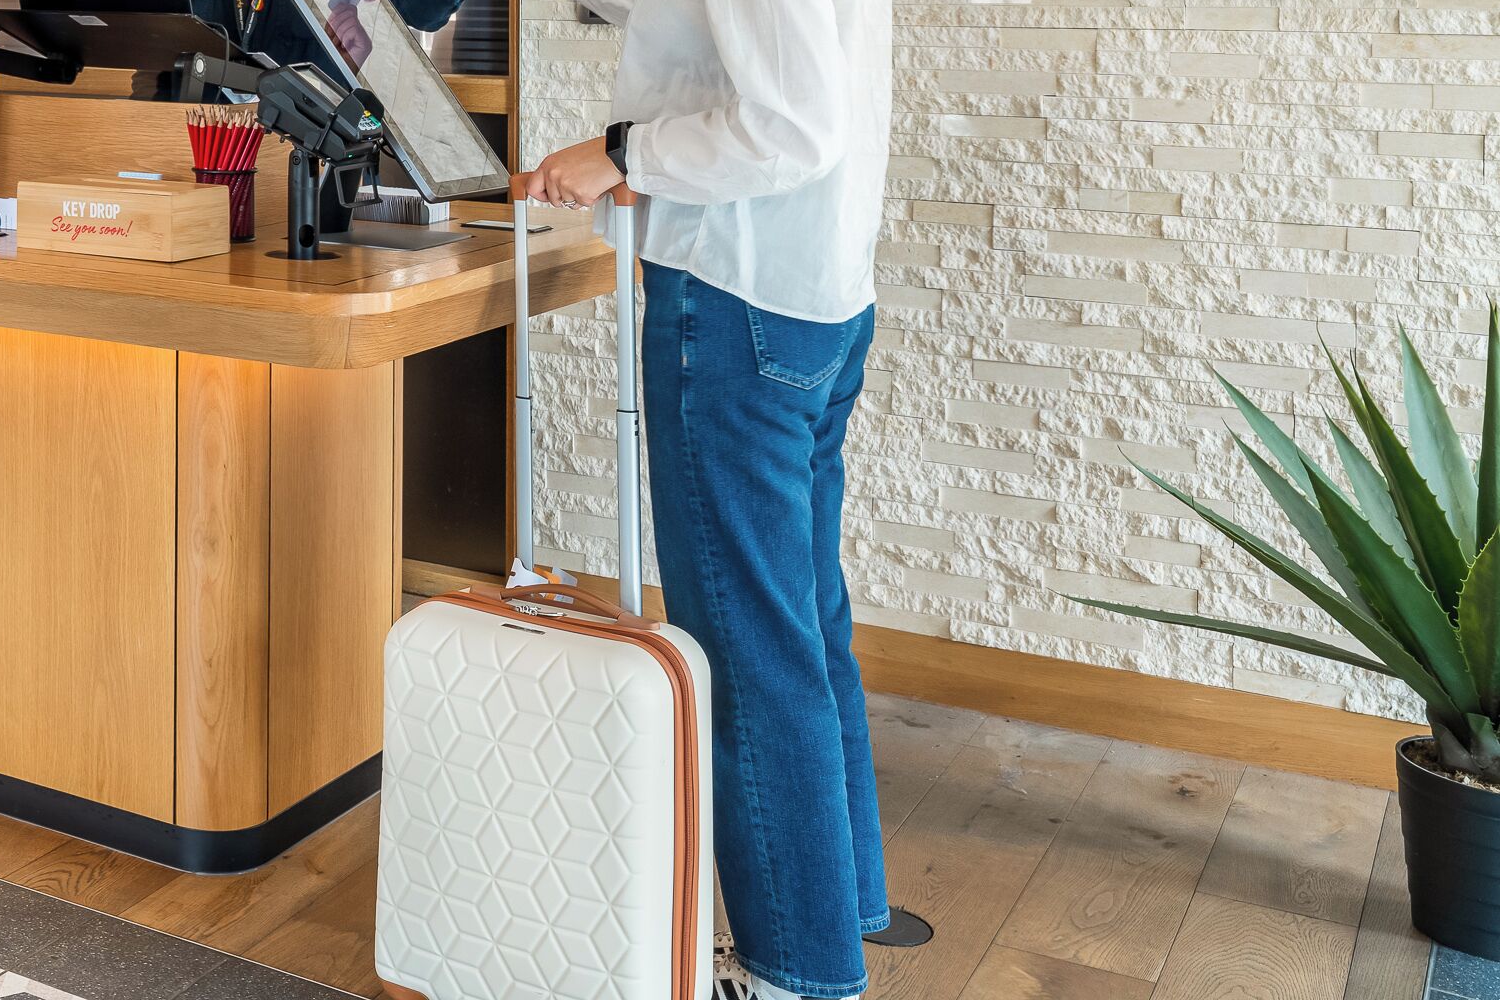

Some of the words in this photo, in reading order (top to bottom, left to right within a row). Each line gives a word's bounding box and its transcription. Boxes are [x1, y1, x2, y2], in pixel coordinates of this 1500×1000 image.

[62, 200, 86, 217] KEY
[89, 202, 121, 219] DROP
[51, 215, 73, 232] See
[71, 224, 97, 241] you
[99, 220, 133, 237] soon!
